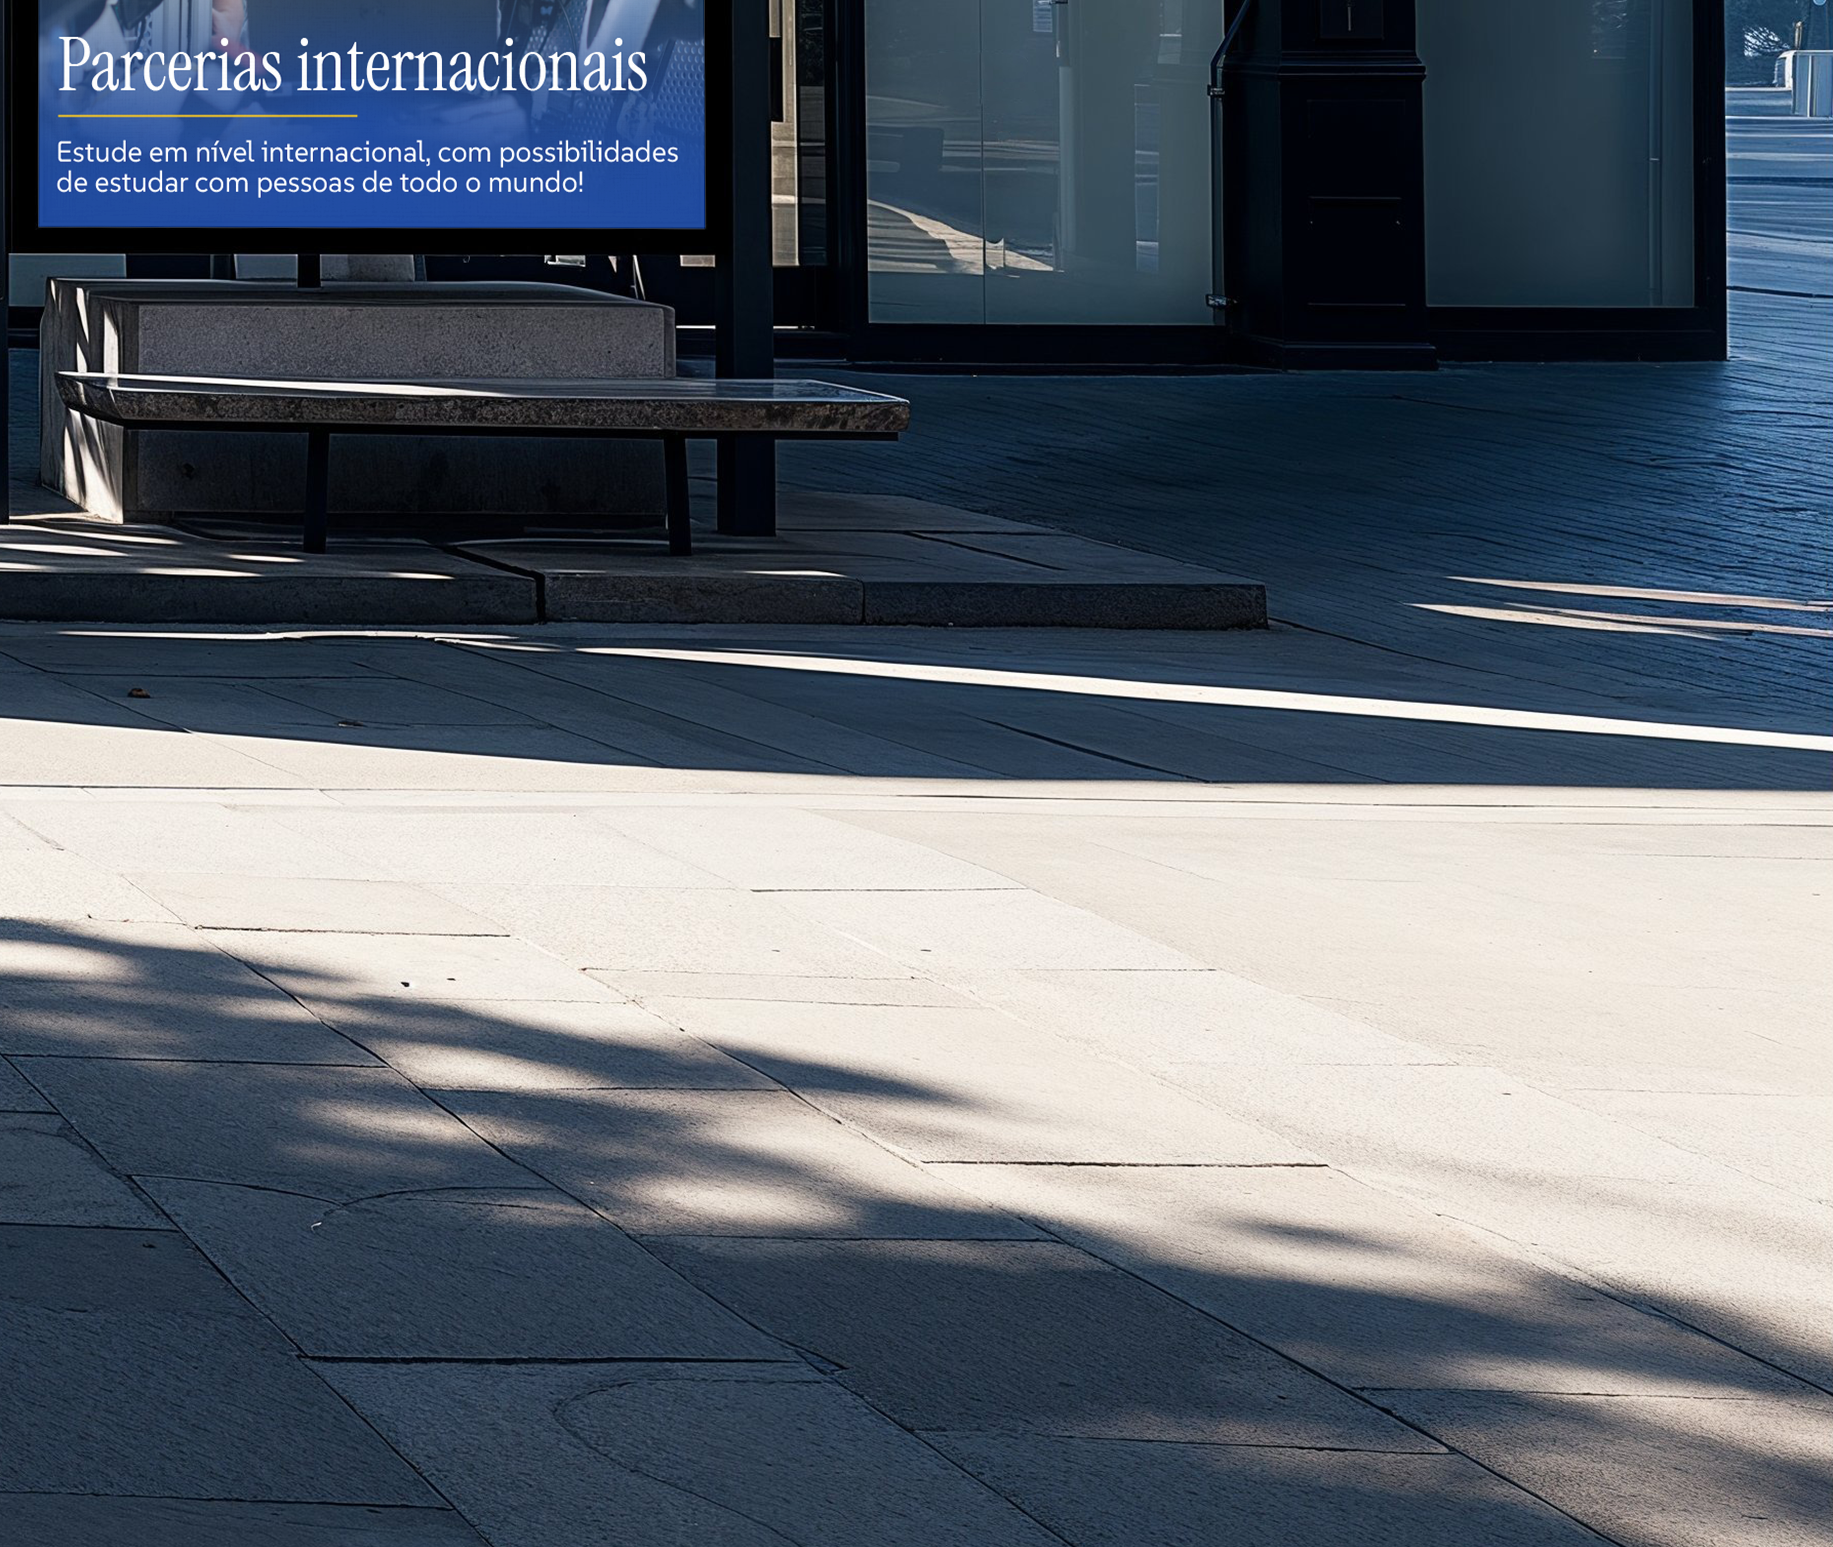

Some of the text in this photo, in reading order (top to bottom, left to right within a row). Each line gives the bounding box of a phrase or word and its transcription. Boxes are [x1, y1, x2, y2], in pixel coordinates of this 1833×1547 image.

[58, 36, 647, 91] Parcerias internacionais
[57, 139, 679, 168] Estude em nível internacional, com possibilidades
[56, 169, 583, 199] de estudar com pessoas de todo o mundo!
